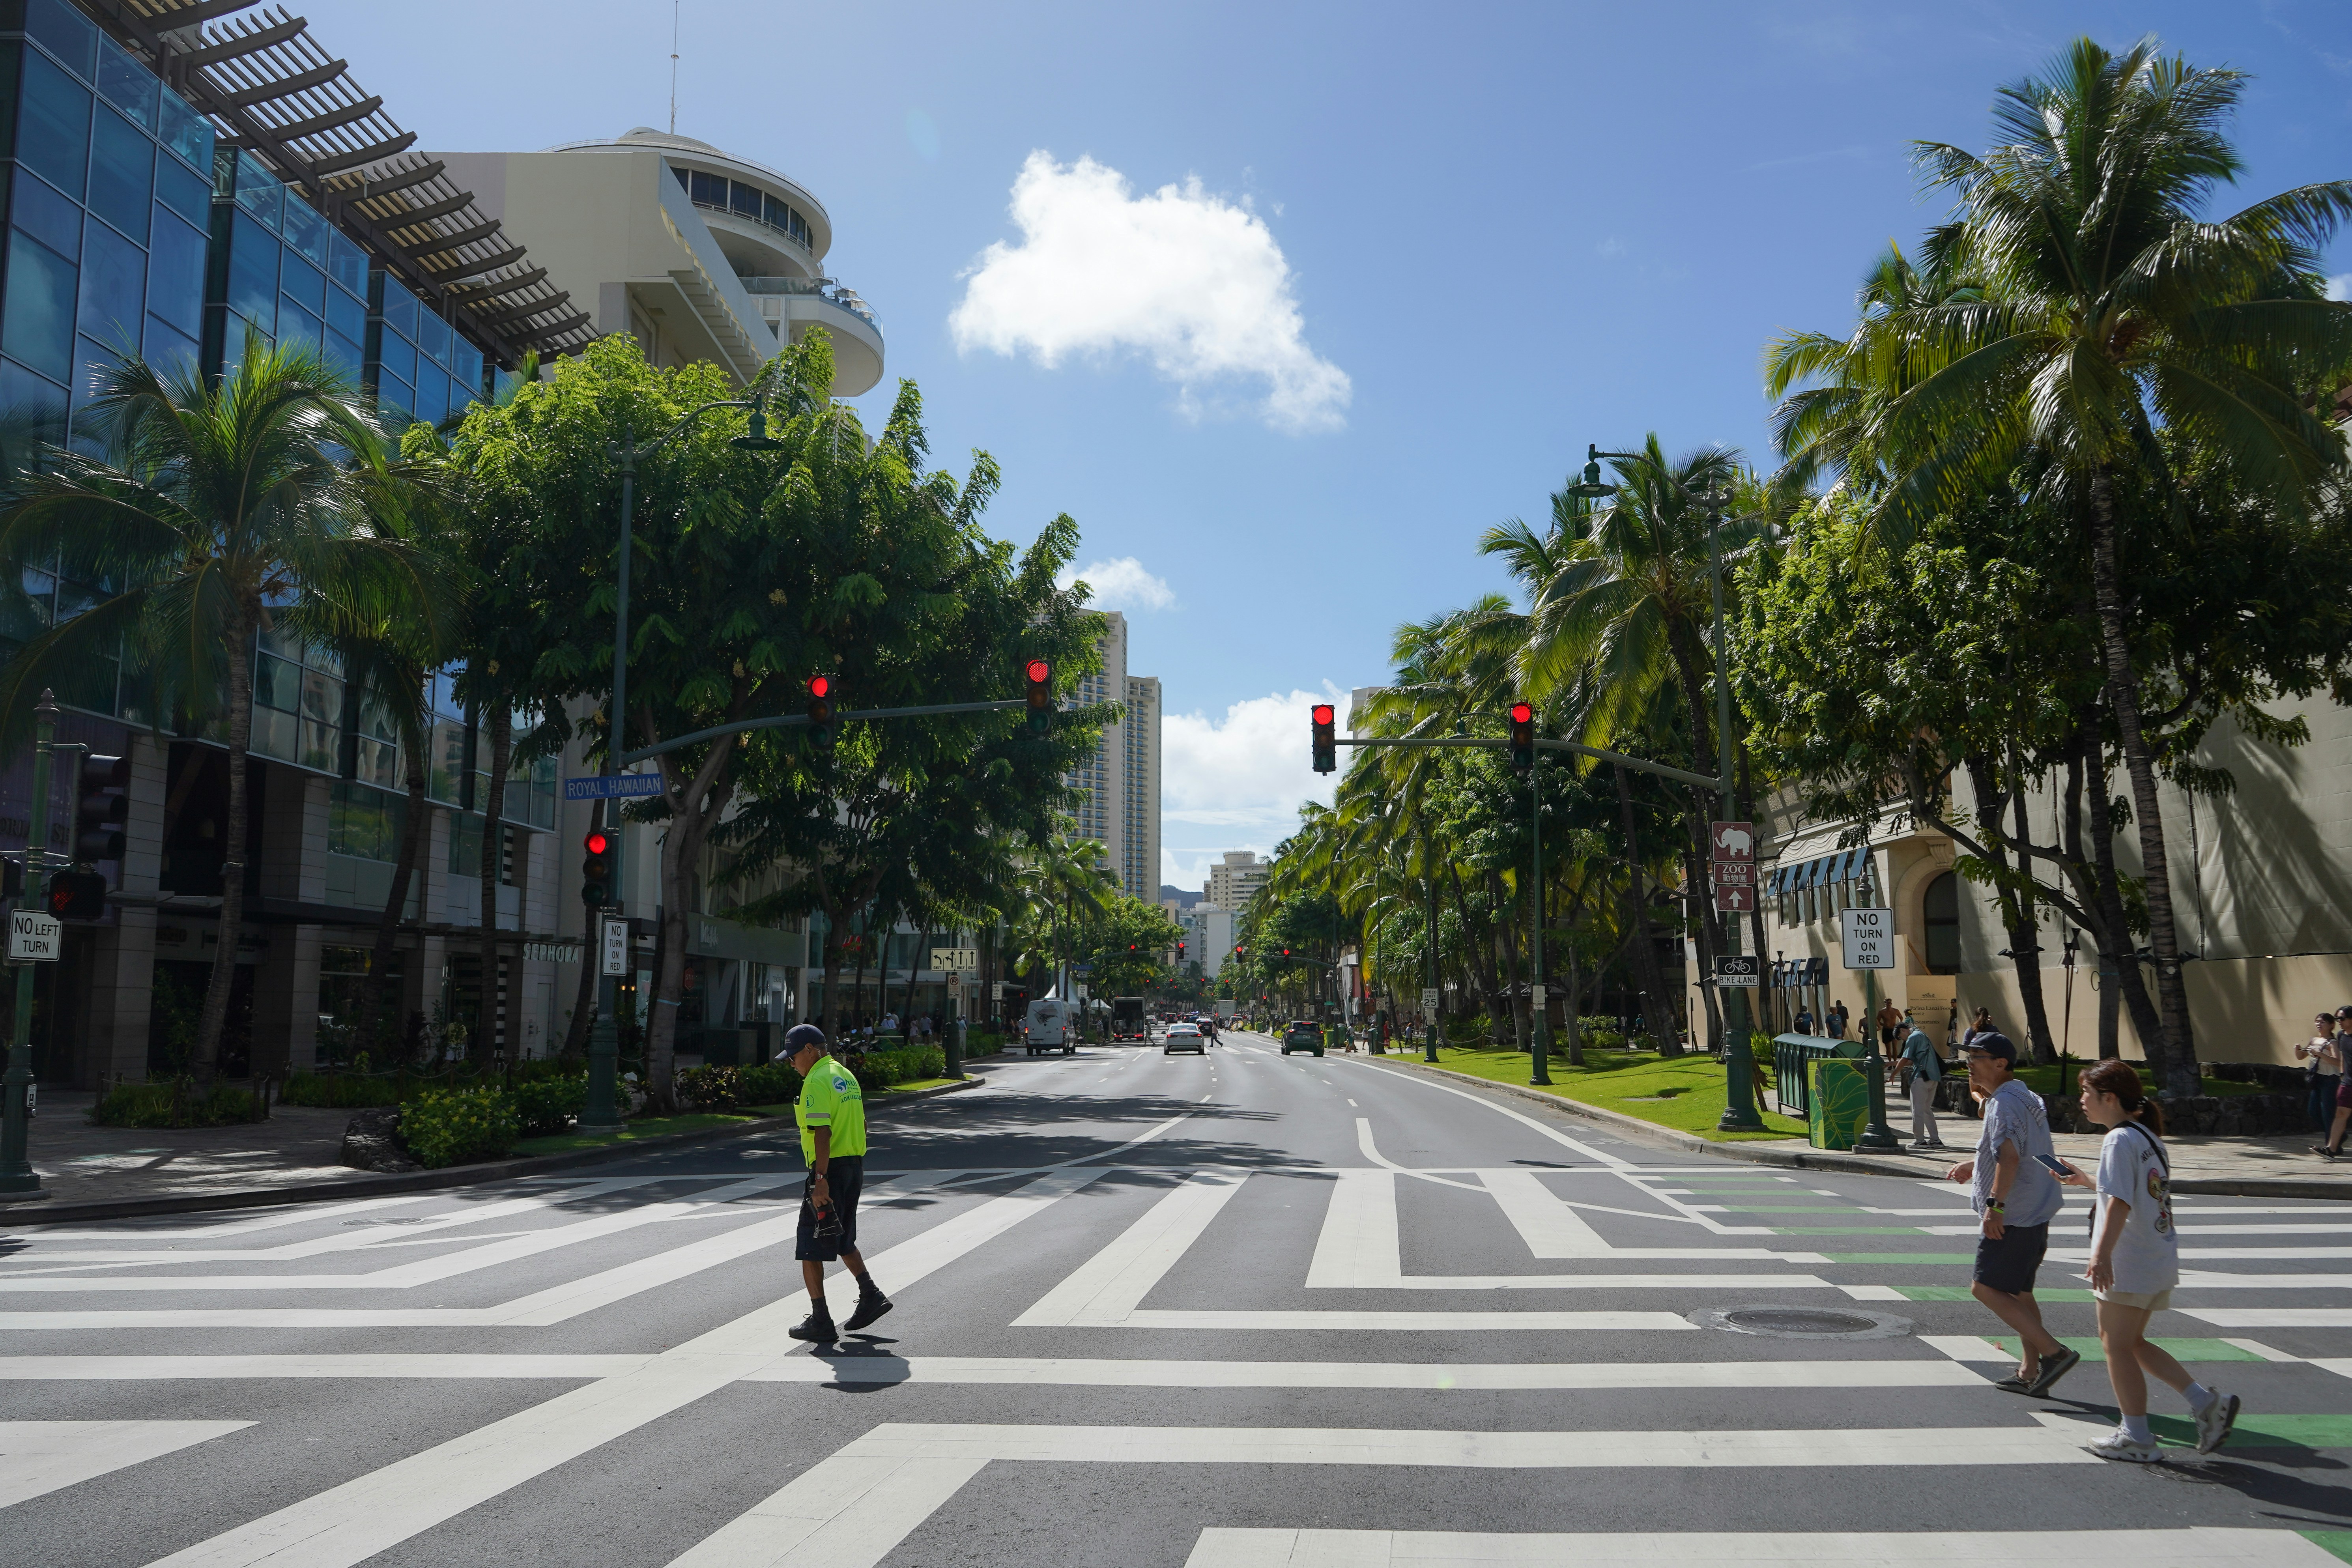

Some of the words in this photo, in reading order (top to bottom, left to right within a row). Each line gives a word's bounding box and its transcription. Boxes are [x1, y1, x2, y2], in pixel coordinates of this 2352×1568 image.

[568, 781, 604, 797] ROYAL
[609, 777, 661, 794] HAWAIIAN
[1722, 865, 1746, 873] ZOO
[1722, 874, 1746, 883] 動物園
[1857, 913, 1878, 925] NO
[15, 917, 32, 934] NO
[36, 923, 59, 936] LEFT
[611, 925, 621, 936] NO
[1853, 929, 1882, 938] TURN
[23, 940, 49, 953] TURN
[609, 939, 622, 948] TURN
[1861, 942, 1875, 951] ON
[522, 943, 578, 963] SEPHORA
[1858, 955, 1879, 964] RED
